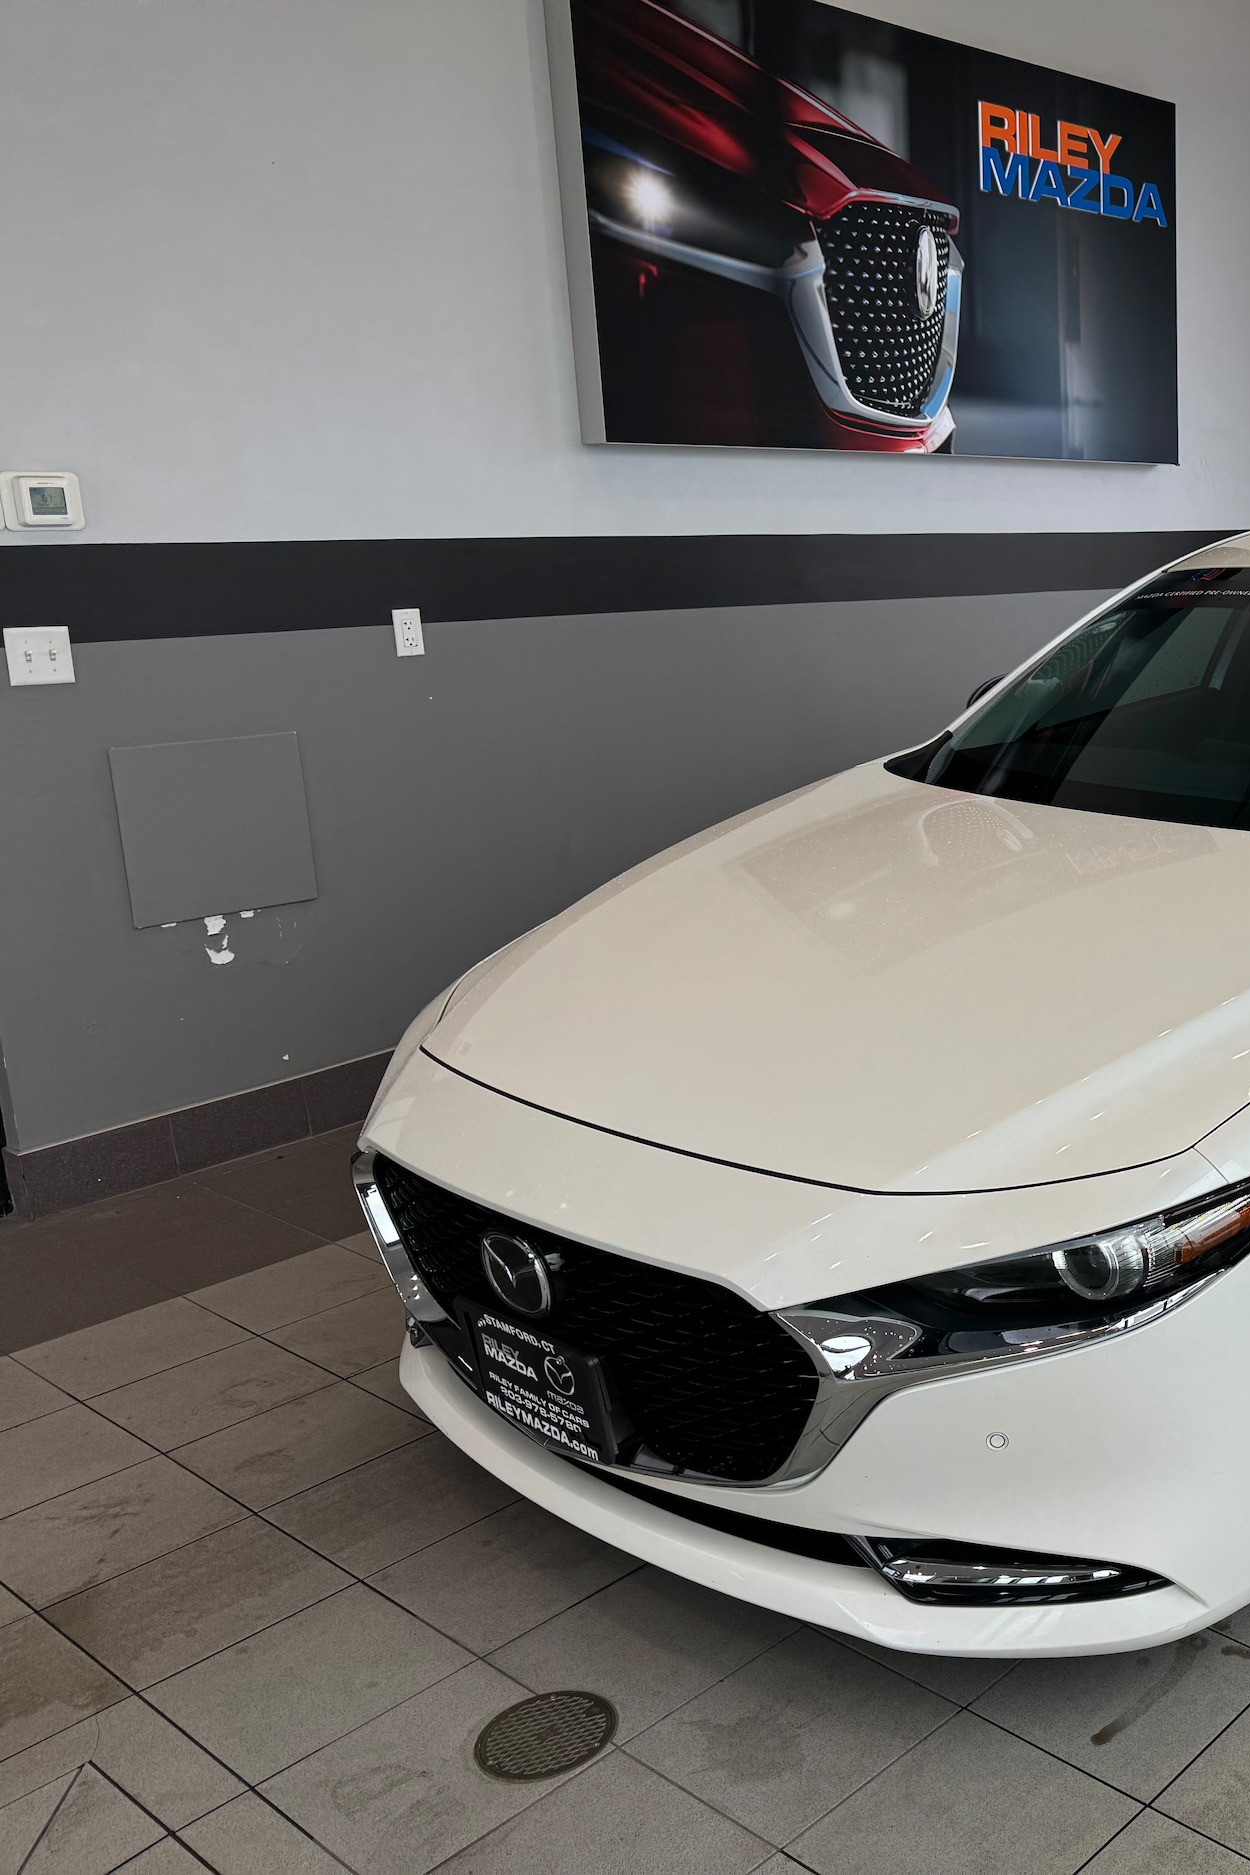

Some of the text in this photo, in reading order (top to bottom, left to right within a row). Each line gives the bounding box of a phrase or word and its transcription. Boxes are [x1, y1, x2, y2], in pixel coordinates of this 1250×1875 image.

[978, 101, 1122, 175] RILEY
[979, 146, 1168, 227] MAZDA
[481, 1333, 520, 1361] RILEY
[484, 1343, 538, 1382] MAZDA
[486, 1390, 599, 1461] RILEYMAZDA.com
[489, 1371, 590, 1429] RILEY FAMILY OF CARS
[547, 1389, 585, 1415] mazda
